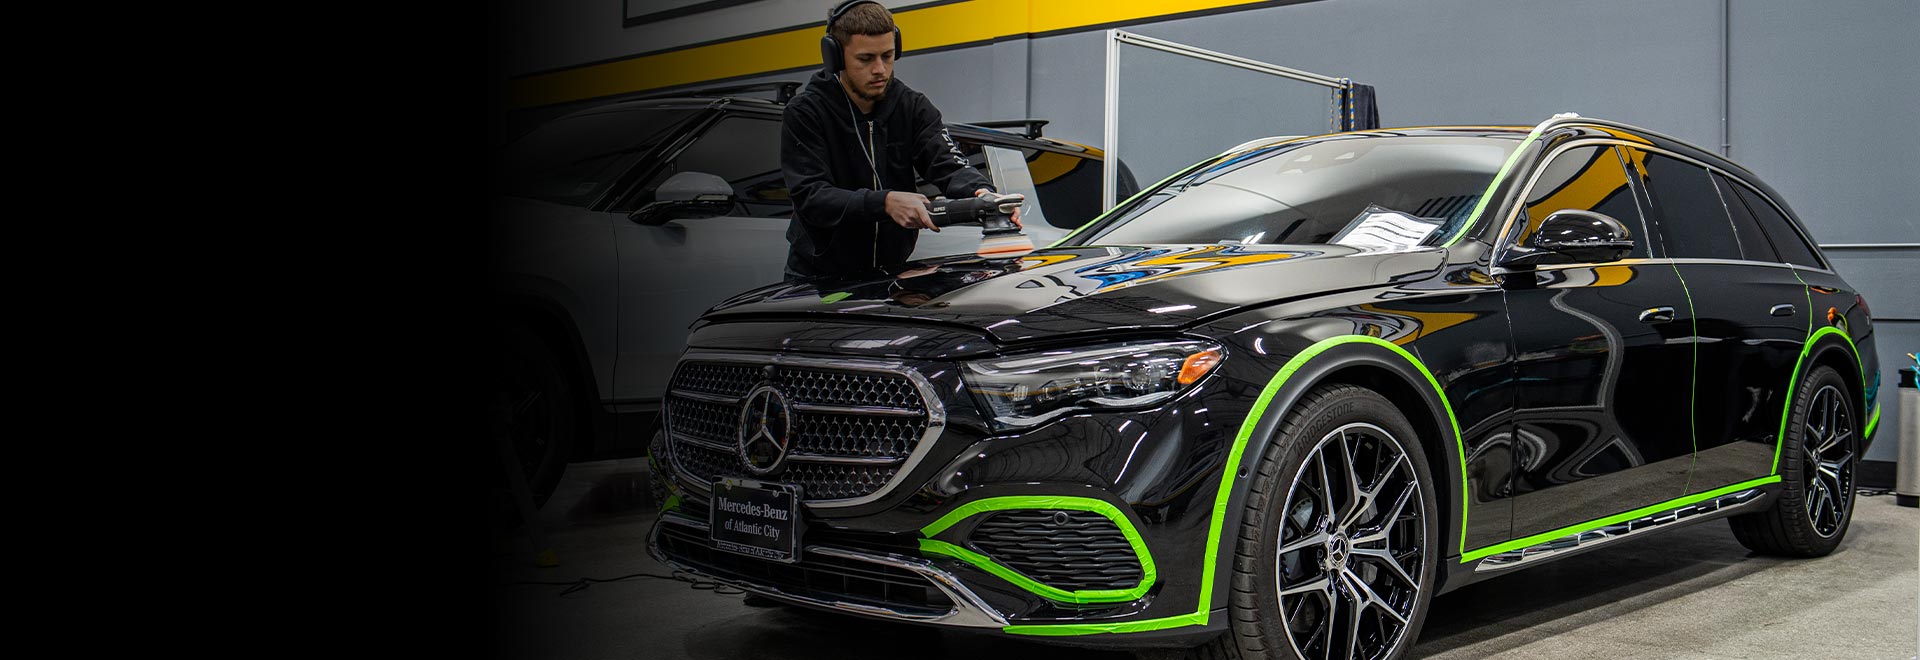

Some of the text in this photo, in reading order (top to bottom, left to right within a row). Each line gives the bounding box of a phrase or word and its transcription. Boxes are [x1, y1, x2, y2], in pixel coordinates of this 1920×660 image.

[718, 496, 788, 521] Mercedes-Benz
[725, 518, 780, 541] of Atlantic City
